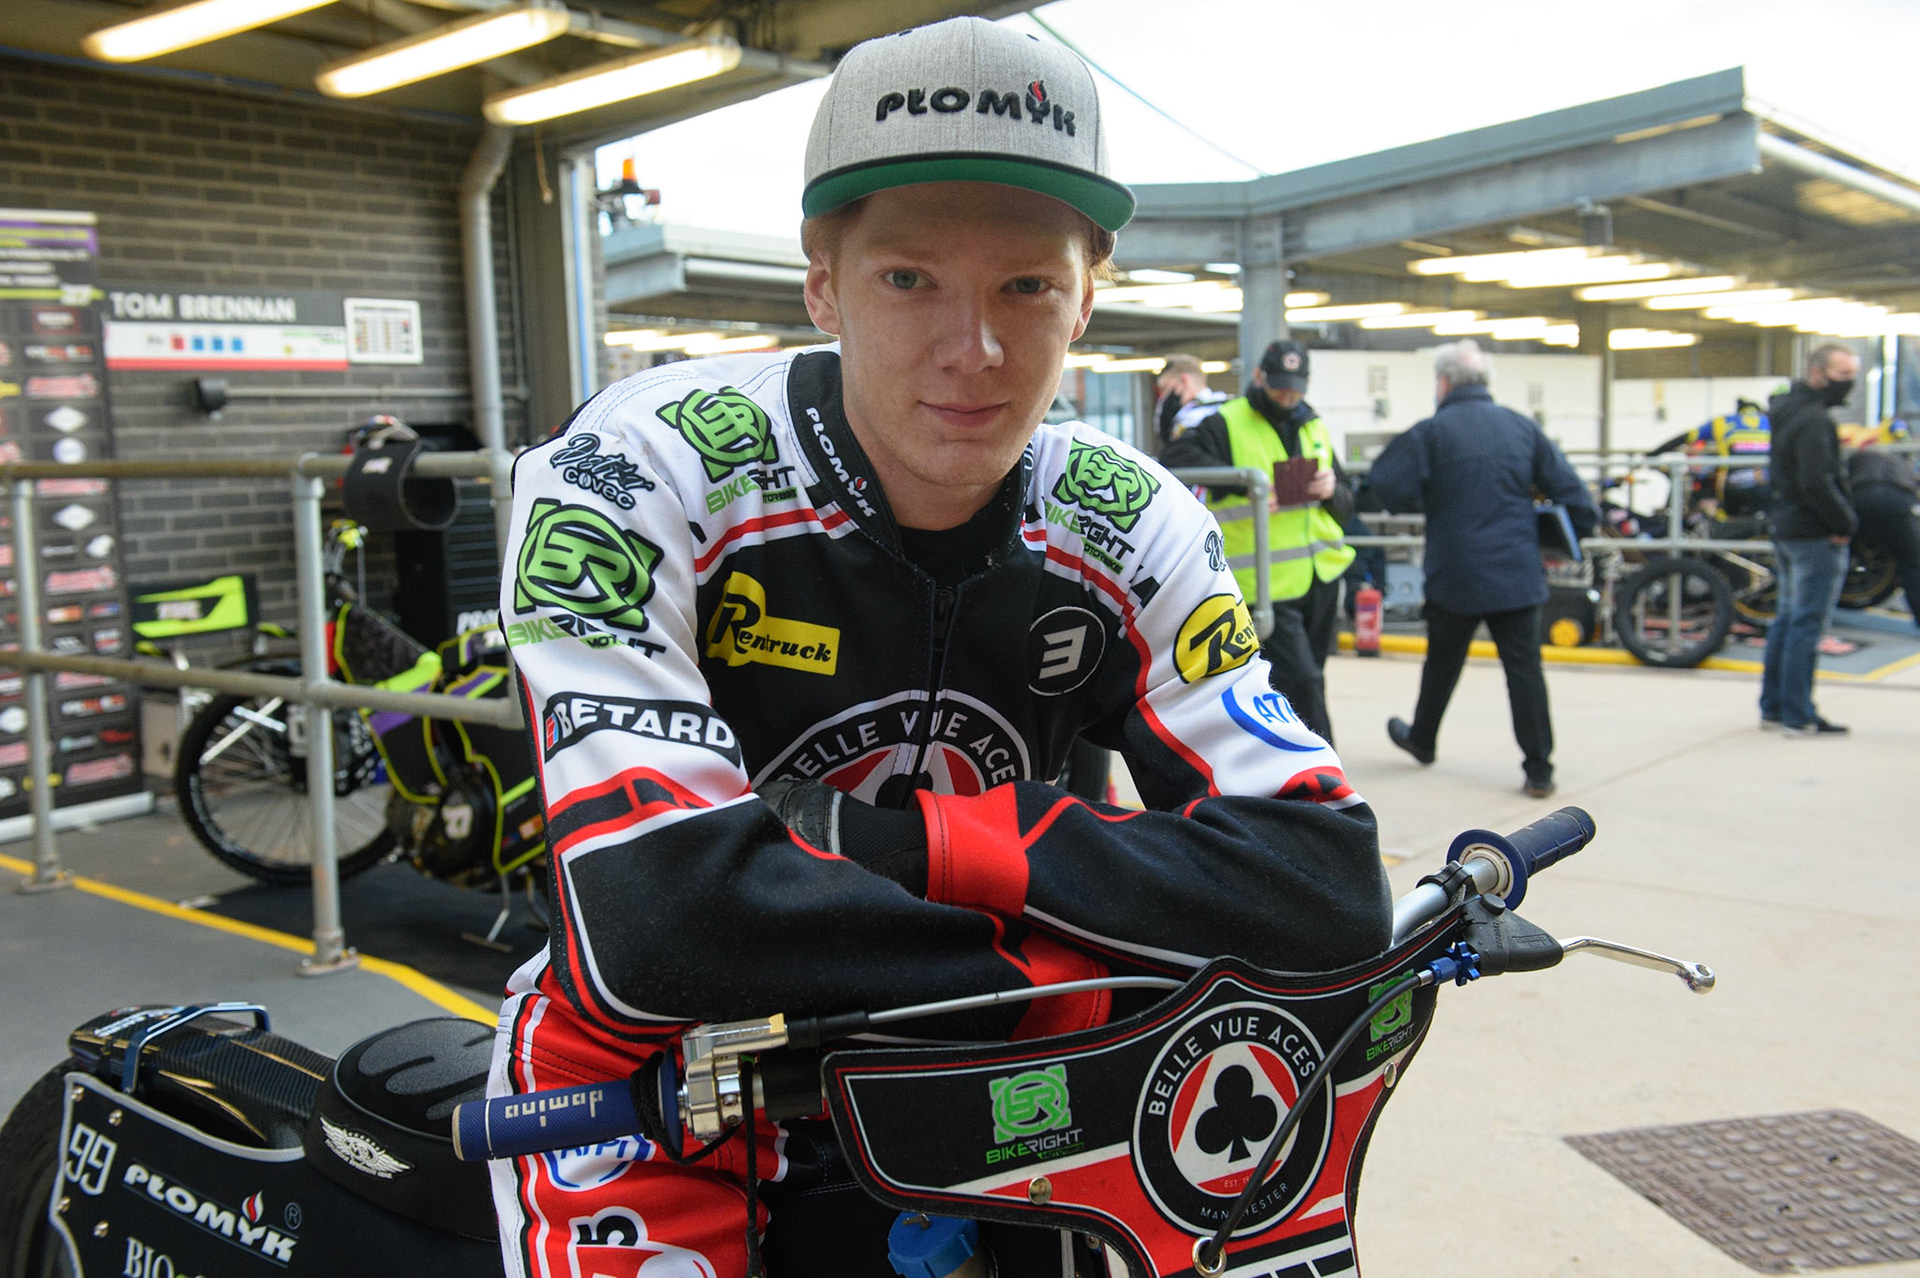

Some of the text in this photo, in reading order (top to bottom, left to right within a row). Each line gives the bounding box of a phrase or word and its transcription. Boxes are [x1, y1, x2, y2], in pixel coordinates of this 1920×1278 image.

[109, 292, 297, 322] TOM BRENNAN
[711, 592, 832, 663] Rentruck
[554, 698, 736, 749] BETARD
[900, 710, 968, 738] VUE
[969, 731, 1016, 785] ACE
[1148, 1016, 1316, 1116] BELLE VUE ACES
[505, 1090, 603, 1127] domino
[64, 1122, 118, 1195] 99
[986, 1128, 1082, 1164] BIKERIGHT
[123, 1164, 298, 1262] PŁOMYK
[1200, 1183, 1288, 1219] MANHESTER
